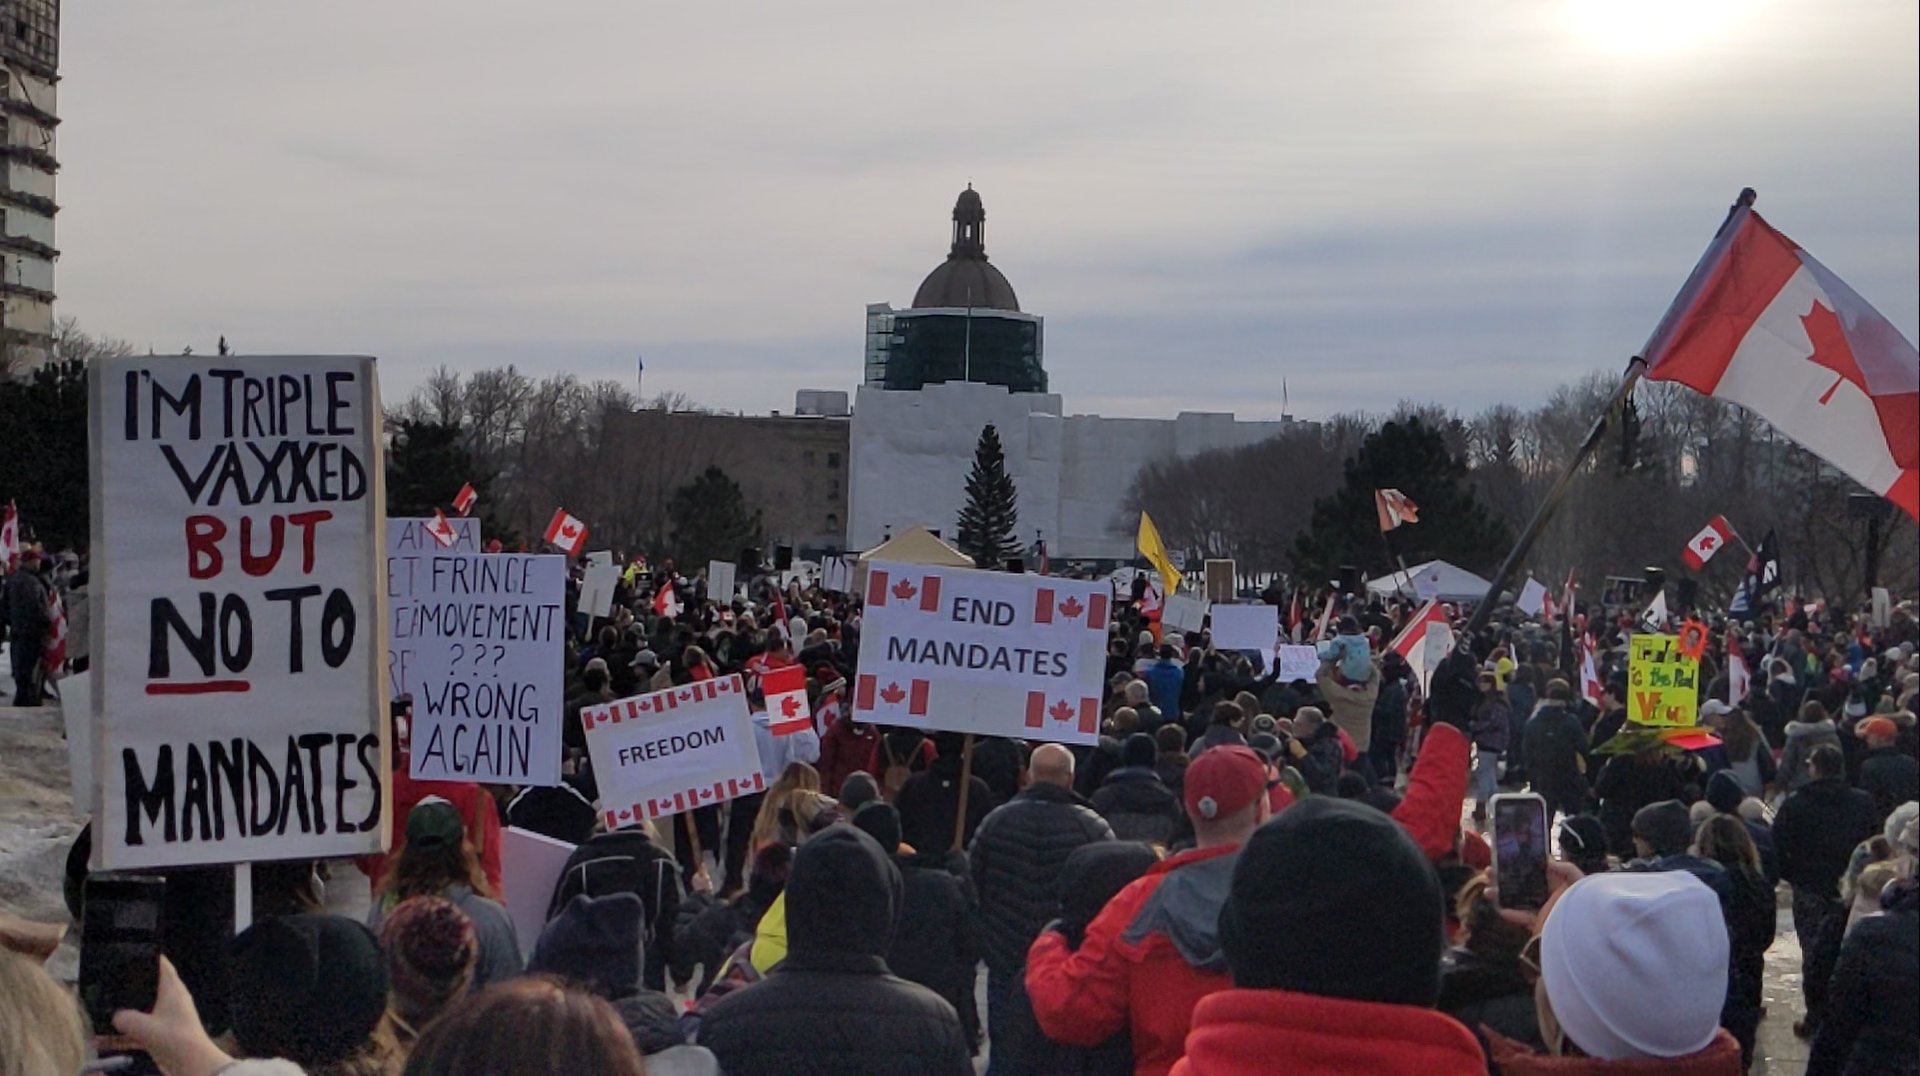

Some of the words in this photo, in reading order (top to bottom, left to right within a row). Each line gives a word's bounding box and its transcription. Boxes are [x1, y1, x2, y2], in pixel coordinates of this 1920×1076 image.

[125, 370, 201, 441] I'M
[209, 369, 355, 437] TRIPLE
[160, 441, 367, 506] VAXXED
[185, 510, 333, 579] BUT
[432, 557, 537, 595] FRINGE
[148, 592, 253, 678] NO
[264, 585, 356, 675] TO
[418, 603, 560, 642] MOVEMENT
[951, 596, 1016, 628] END
[886, 635, 1070, 678] MANDATES
[422, 681, 539, 724] WRONG
[419, 722, 531, 777] AGAIN
[617, 725, 726, 767] FREEDOM
[122, 734, 382, 846] MANDATES
